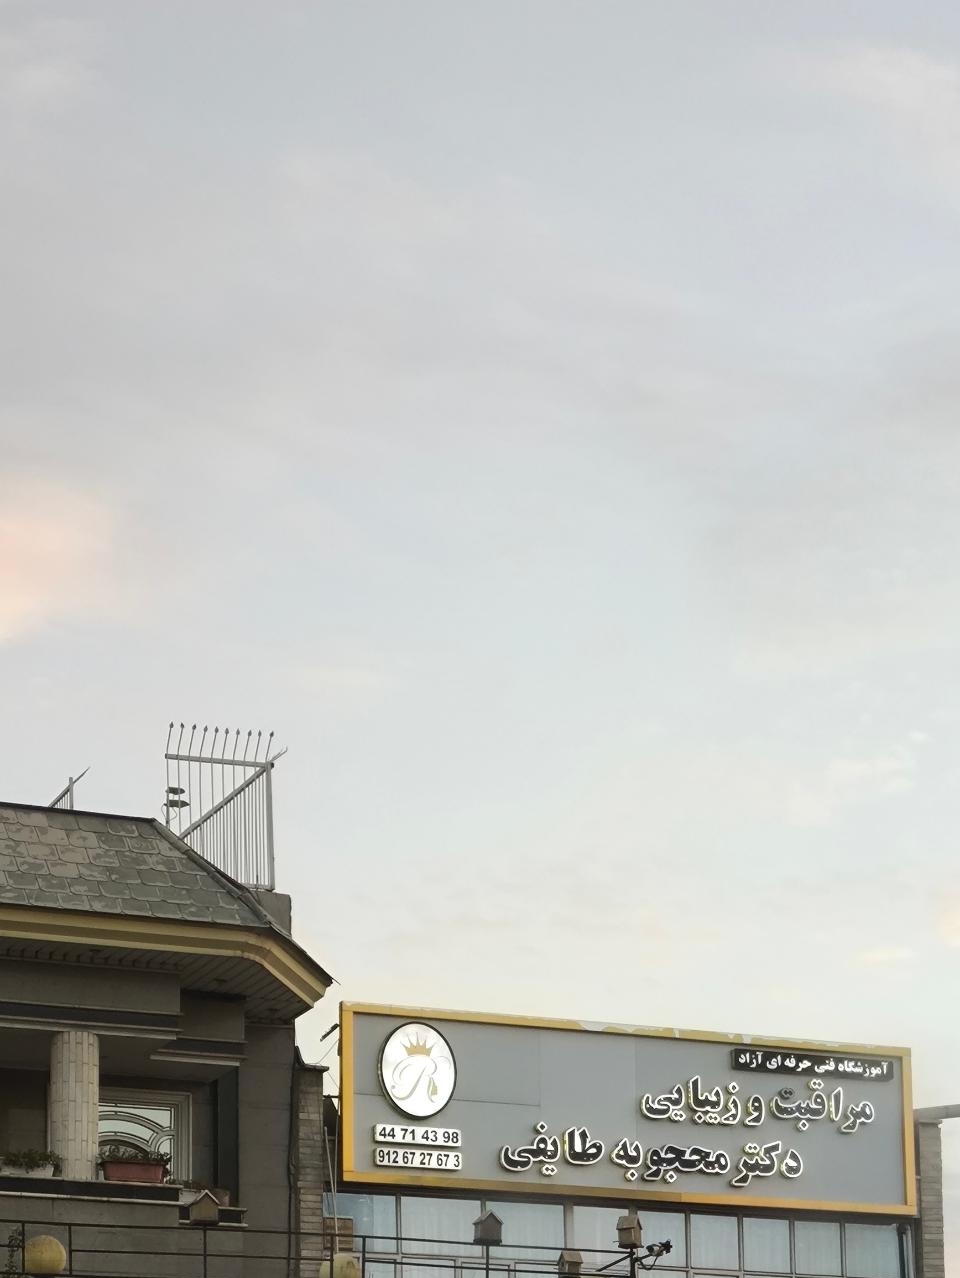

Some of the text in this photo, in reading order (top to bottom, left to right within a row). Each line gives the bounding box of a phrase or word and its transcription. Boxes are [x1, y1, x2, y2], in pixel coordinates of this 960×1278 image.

[738, 1051, 889, 1078] آموزشگاه فنی حرفه ای آزاد
[640, 1074, 876, 1133] مراقبت و زیبایی
[378, 1126, 459, 1144] 44 71 43 98
[500, 1121, 605, 1177] طایفی
[378, 1149, 460, 1168] 912 67 27 67 3
[730, 1140, 804, 1187] دکتر
